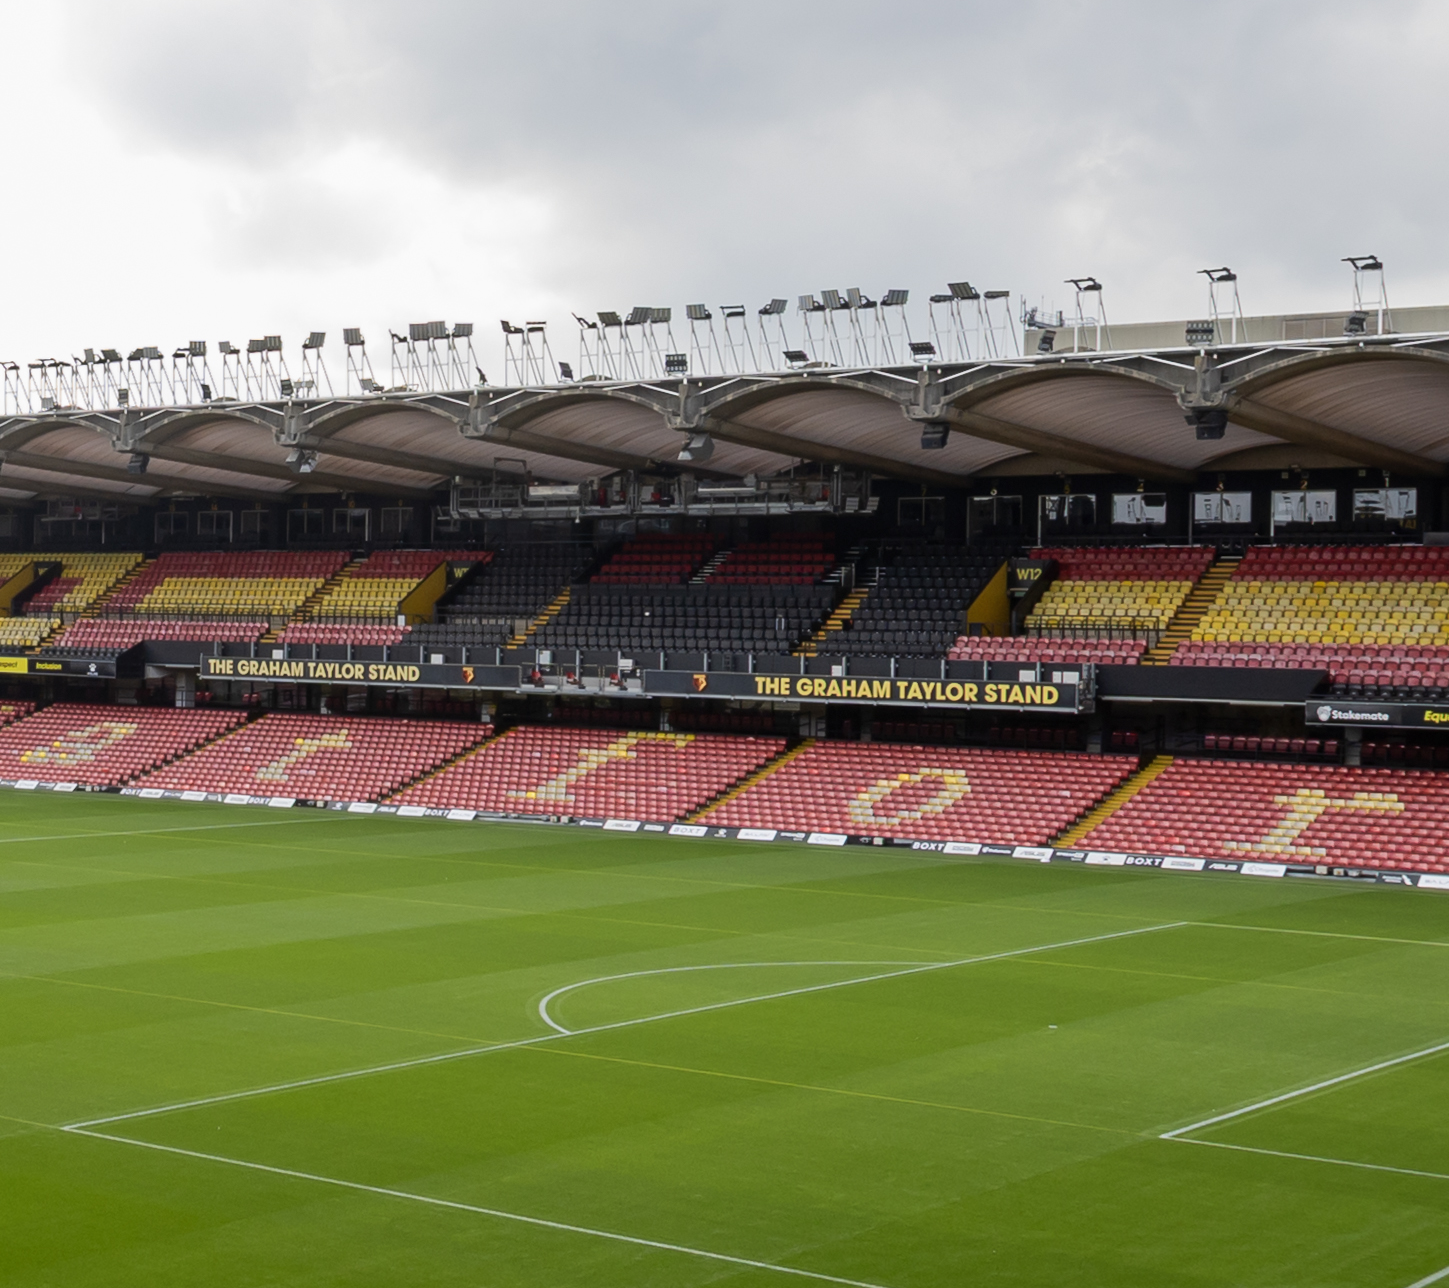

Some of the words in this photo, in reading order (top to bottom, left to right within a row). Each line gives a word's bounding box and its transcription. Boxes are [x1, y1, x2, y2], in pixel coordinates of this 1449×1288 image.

[1016, 568, 1042, 580] W12
[36, 661, 62, 670] Inclusion
[208, 659, 234, 675] THE
[237, 660, 304, 677] GRAHAM
[307, 662, 364, 680] TAYLOR
[368, 664, 420, 681] STAND
[755, 676, 791, 695] THE
[796, 678, 892, 699] GRAHAM
[897, 681, 978, 701] TAYLOR
[984, 683, 1059, 704] STAND
[1331, 709, 1390, 721] Stakemate
[424, 808, 450, 817] BOXT
[673, 826, 702, 834] BOXT
[912, 842, 945, 852] BOXT
[1125, 856, 1163, 867] BOXT
